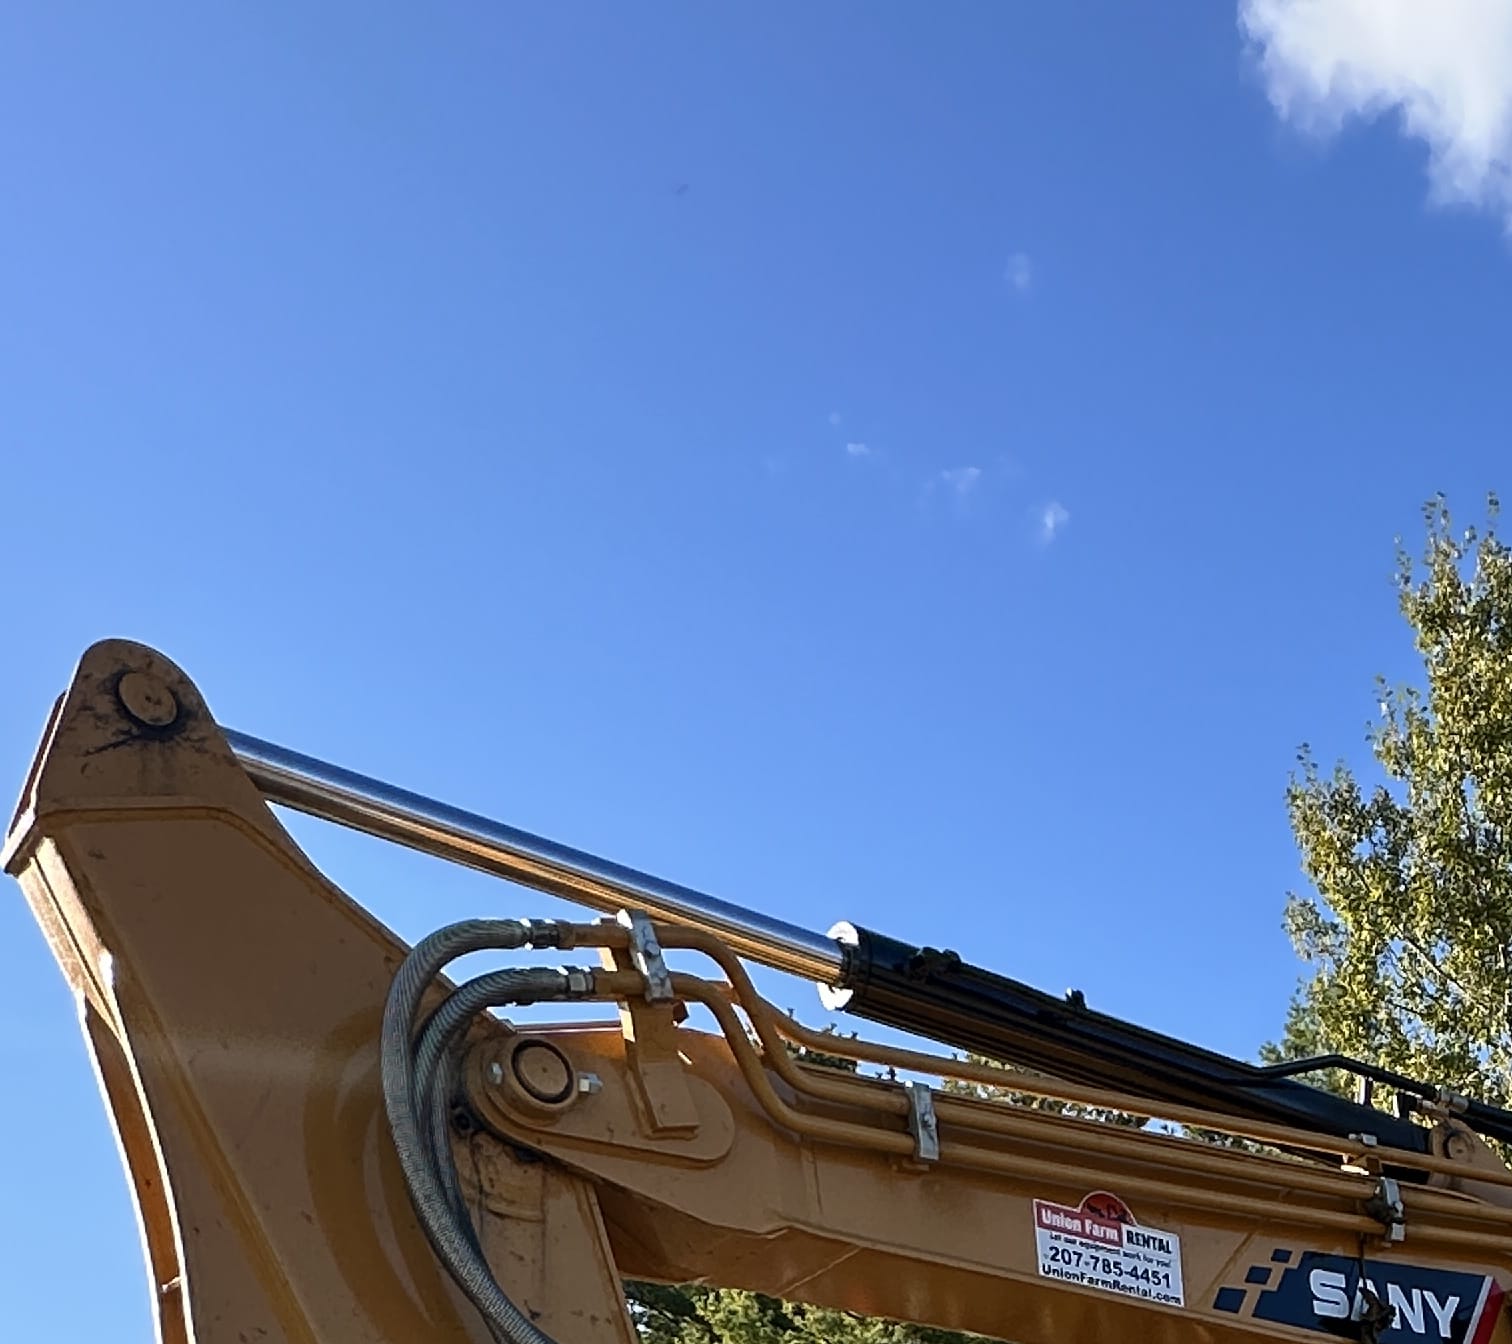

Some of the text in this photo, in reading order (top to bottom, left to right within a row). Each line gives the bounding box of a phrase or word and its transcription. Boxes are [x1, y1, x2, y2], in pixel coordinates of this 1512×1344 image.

[1041, 1207, 1119, 1241] Union Farm
[1126, 1230, 1172, 1255] RENTAL
[1042, 1263, 1182, 1306] UnionFarmRental.com
[1048, 1246, 1171, 1289] 207-785-4451
[1309, 1268, 1460, 1338] SANY
